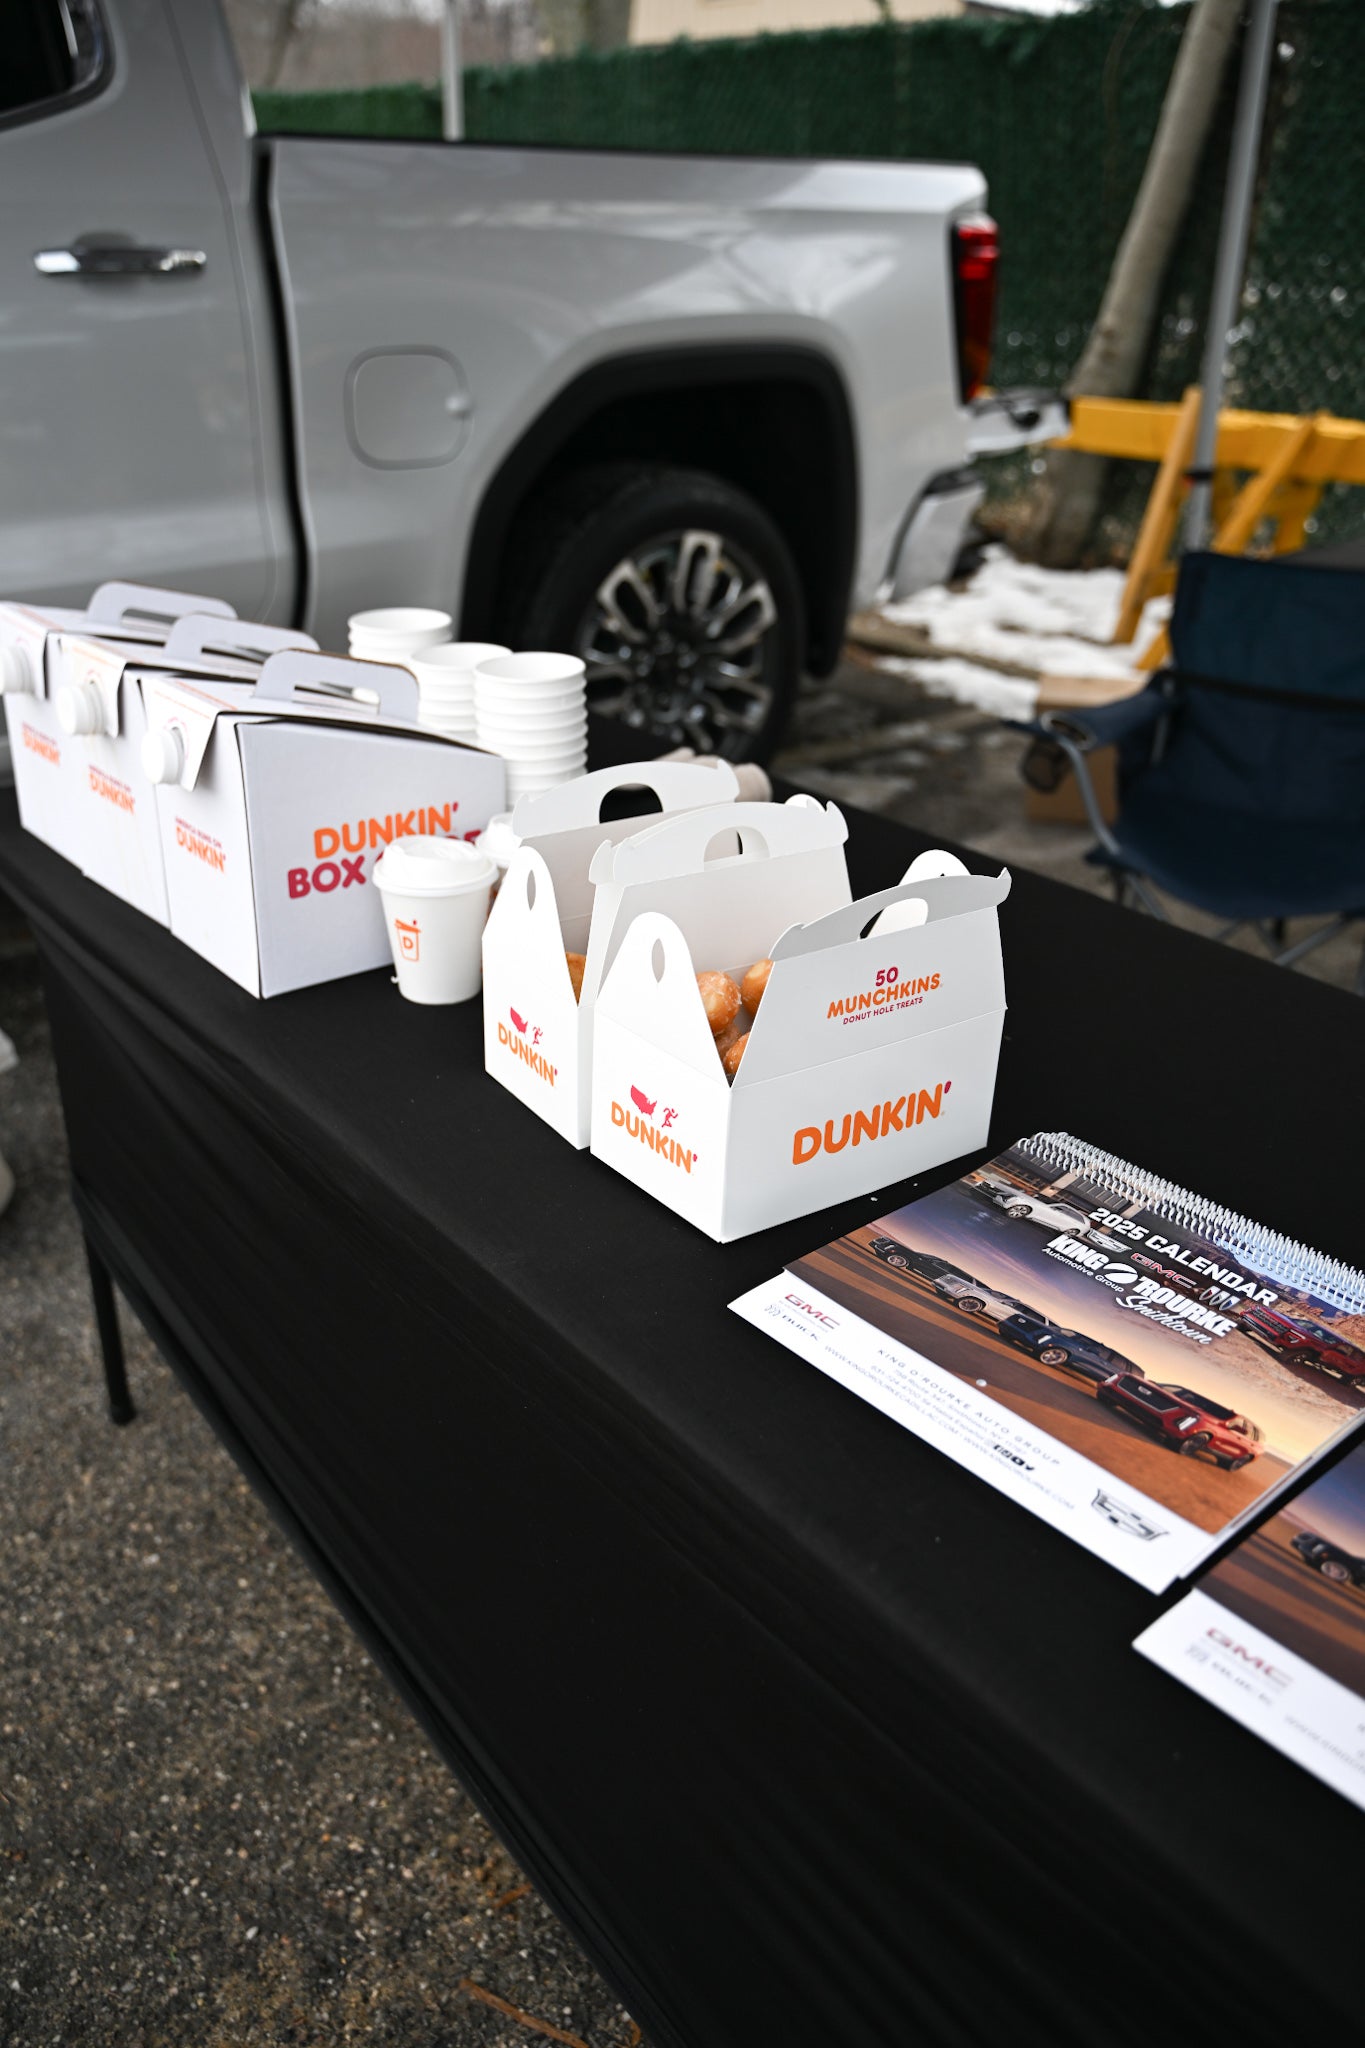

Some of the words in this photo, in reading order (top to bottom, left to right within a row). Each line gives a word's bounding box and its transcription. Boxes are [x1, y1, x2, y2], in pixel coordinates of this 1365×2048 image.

[176, 826, 226, 873] DUNKIN'
[314, 802, 458, 859] DUNKIN'
[288, 855, 366, 899] BOX
[827, 973, 941, 1019] MUNCHKINS
[875, 966, 899, 987] 50
[843, 1011, 872, 1025] DONUT
[873, 1004, 894, 1017] HOLE
[896, 996, 924, 1010] TREATS
[498, 1022, 558, 1087] DUNKIN'
[611, 1101, 698, 1174] DUNKIN'
[792, 1080, 952, 1166] DUNKIN'
[1042, 1247, 1094, 1277] Automotive
[1094, 1274, 1125, 1293] Group
[1046, 1233, 1110, 1271] KING
[1088, 1207, 1150, 1242] 2025
[1144, 1234, 1279, 1307] CALENDAR
[1130, 1252, 1198, 1289] GMC
[785, 1294, 840, 1330] GMC
[1115, 1294, 1212, 1345] Smithtown
